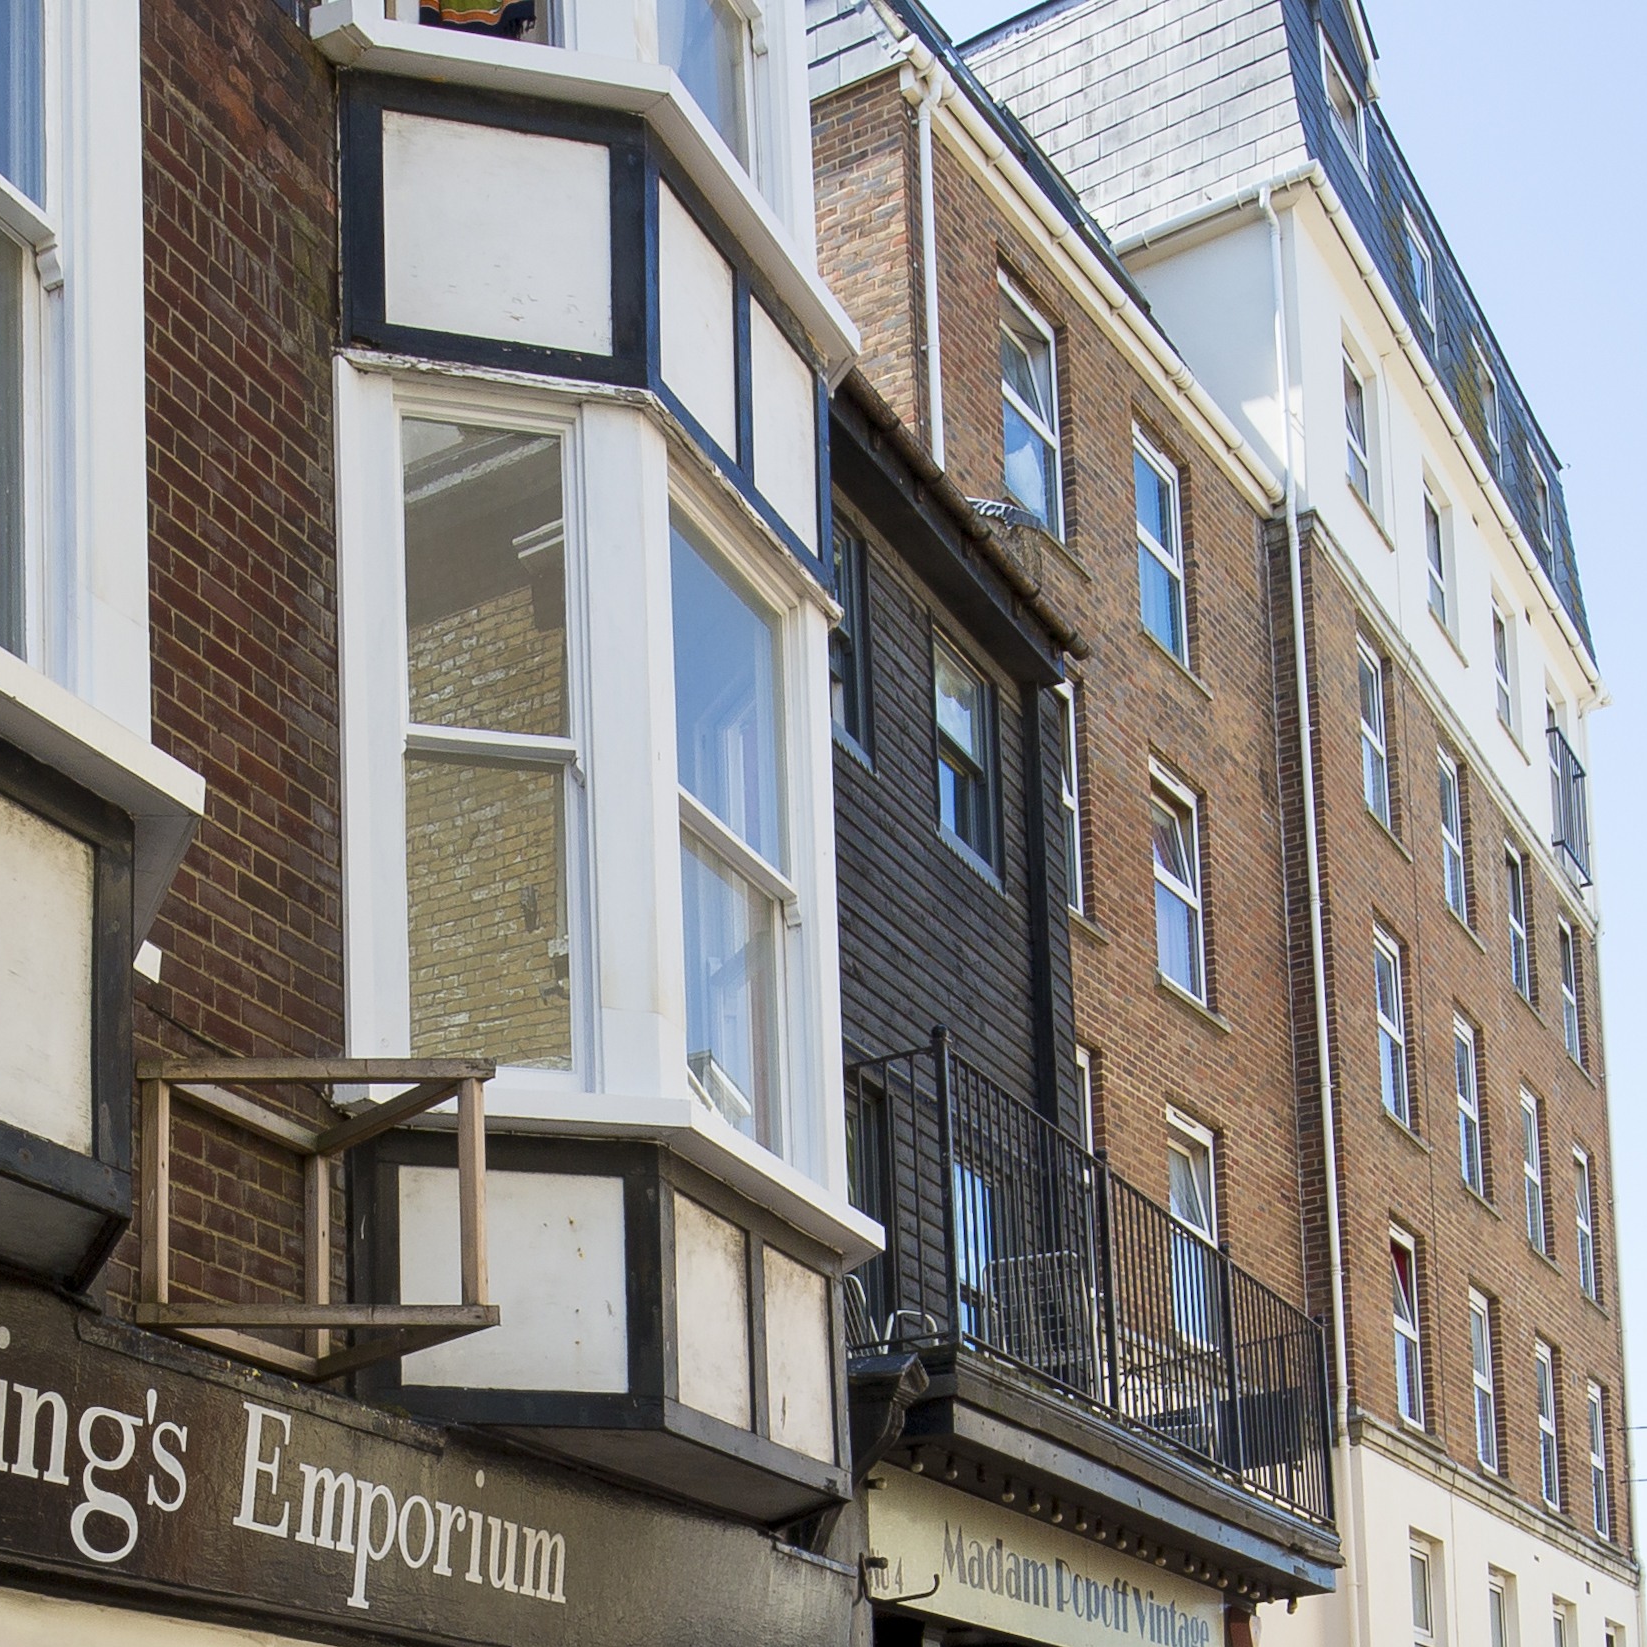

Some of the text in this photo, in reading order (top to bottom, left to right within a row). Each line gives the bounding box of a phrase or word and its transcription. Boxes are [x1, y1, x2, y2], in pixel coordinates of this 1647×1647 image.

[232, 1400, 567, 1609] Emporium
[941, 1519, 1051, 1610] Madam
[1054, 1556, 1130, 1634] Popoff
